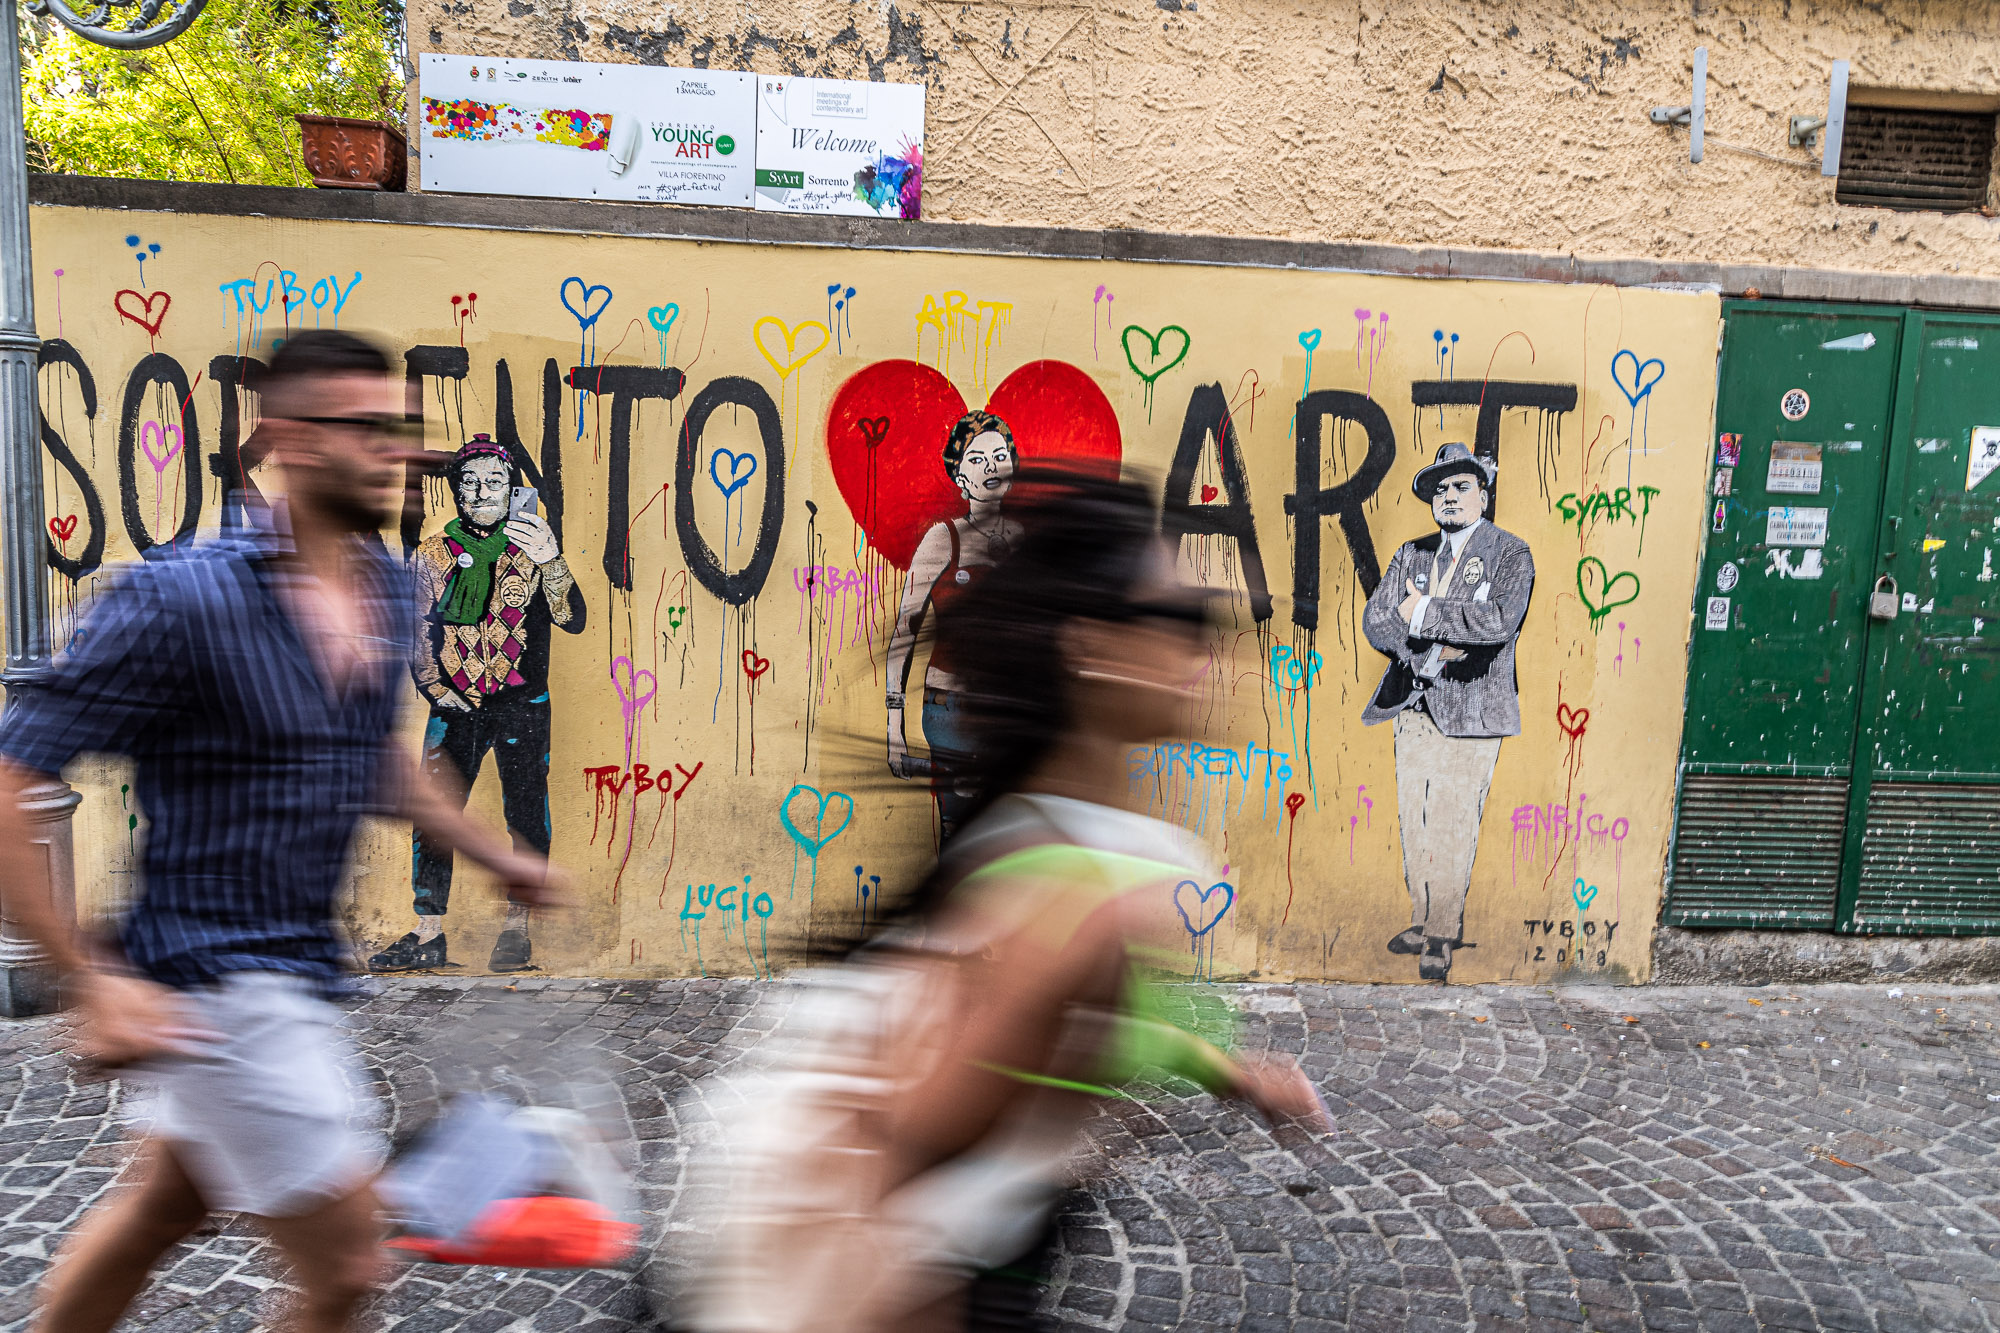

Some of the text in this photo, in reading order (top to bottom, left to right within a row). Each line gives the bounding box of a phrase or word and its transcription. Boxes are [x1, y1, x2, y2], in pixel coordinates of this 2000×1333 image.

[816, 98, 842, 107] meetings
[816, 105, 854, 114] contemporary
[651, 121, 715, 130] SORRENTO
[651, 127, 713, 145] YOUNG
[675, 142, 713, 159] ART
[792, 128, 877, 153] Welcome
[658, 171, 726, 181] VILLA FIORENTINO
[768, 171, 800, 186] SyArt
[808, 175, 849, 187] Sorrento
[915, 290, 1013, 347] ART
[1160, 378, 1578, 630] ART
[1556, 489, 1660, 527] SYART
[793, 565, 882, 600] URBAN
[1271, 645, 1323, 692] POP
[1126, 739, 1293, 790] SORRENTO
[680, 875, 774, 921] LUCIO
[1524, 919, 1618, 940] TVBOY
[1533, 946, 1606, 967] 2018
